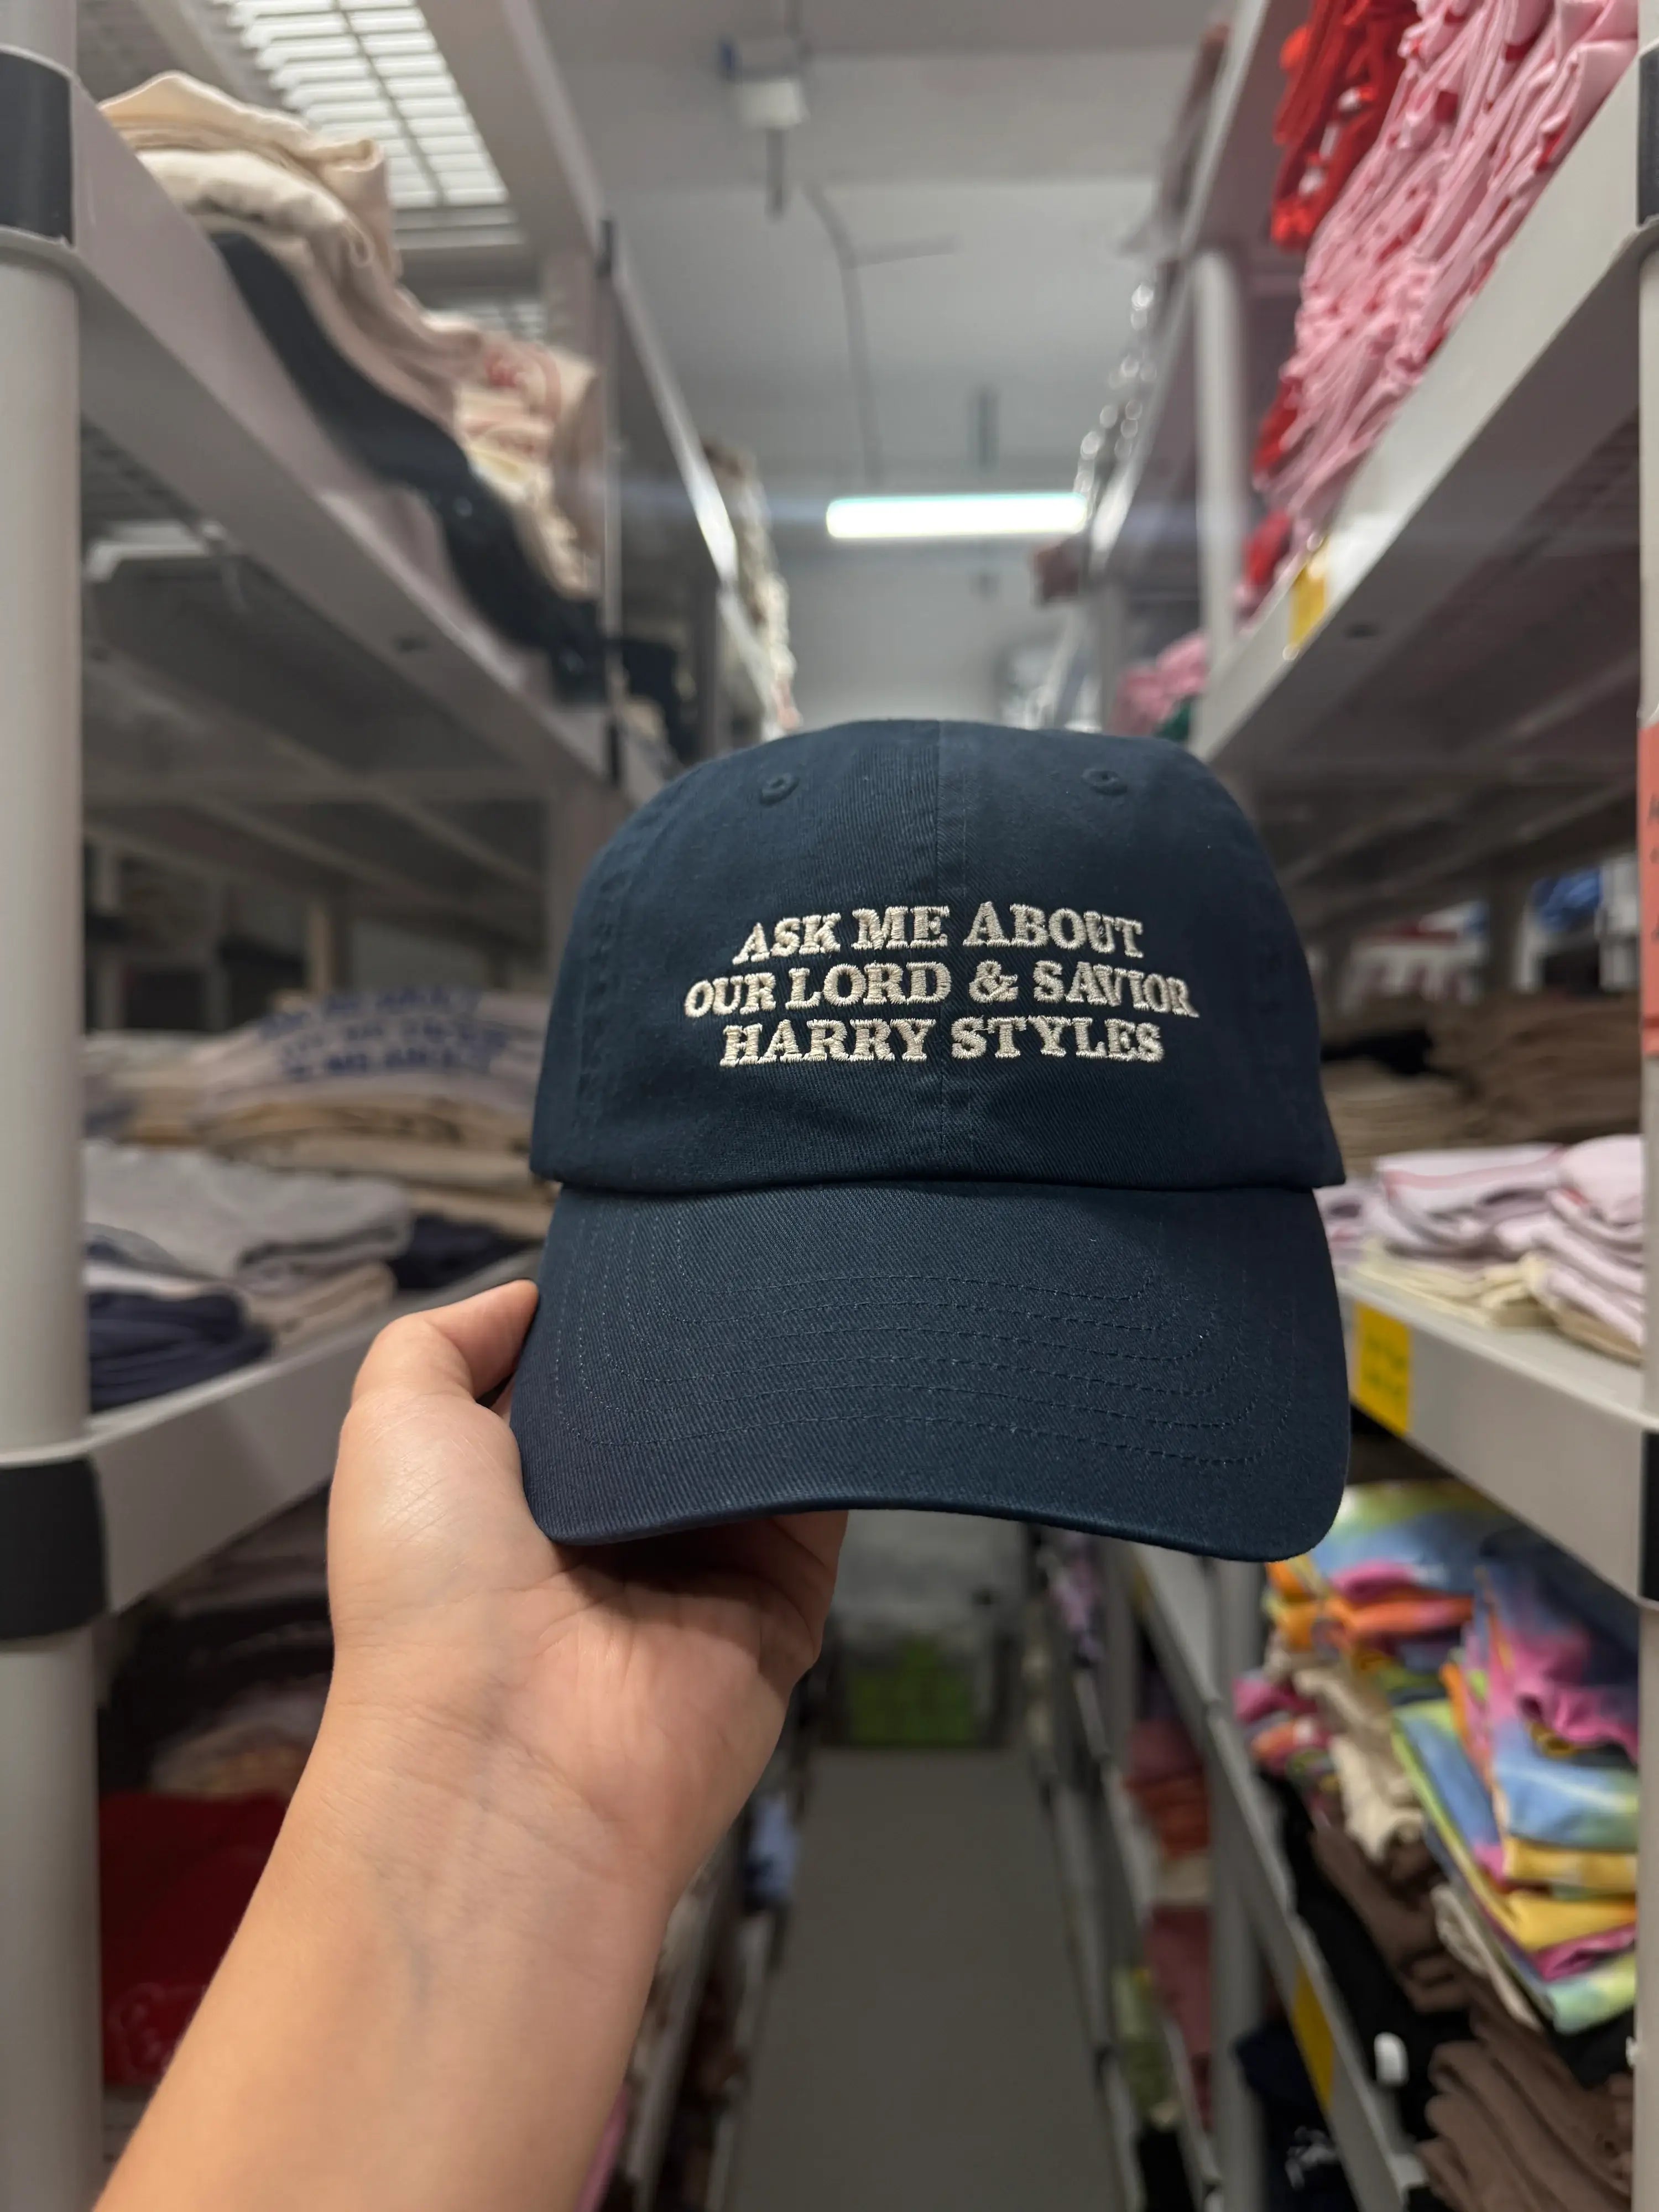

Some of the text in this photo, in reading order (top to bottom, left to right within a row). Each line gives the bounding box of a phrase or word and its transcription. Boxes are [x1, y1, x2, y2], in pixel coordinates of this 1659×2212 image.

[733, 901, 1143, 964] ASK ME ABOUT
[684, 959, 1199, 1018] OUR LORD & SAVIOR
[719, 1015, 1164, 1067] HARRY STYLES
